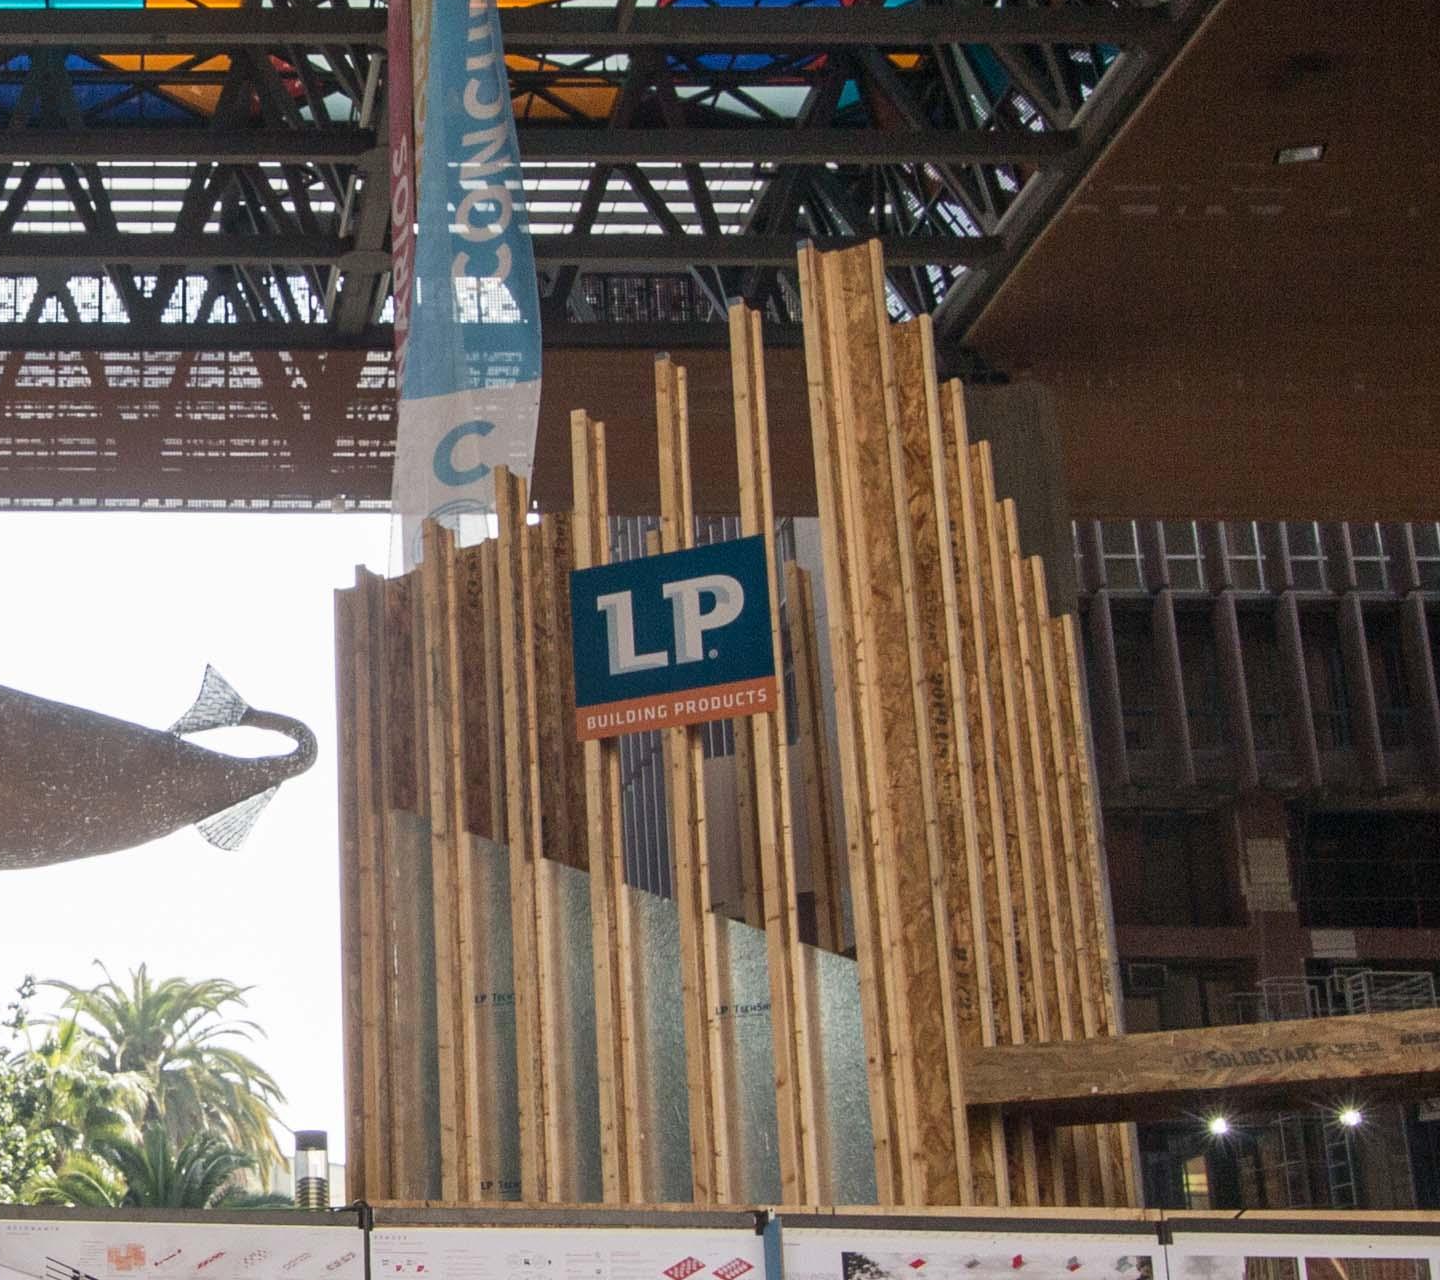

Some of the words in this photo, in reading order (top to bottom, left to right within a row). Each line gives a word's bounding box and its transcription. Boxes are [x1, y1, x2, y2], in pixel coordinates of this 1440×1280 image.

[597, 574, 745, 676] LP
[586, 704, 668, 731] BUILDING
[674, 688, 768, 716] PRODUCTS
